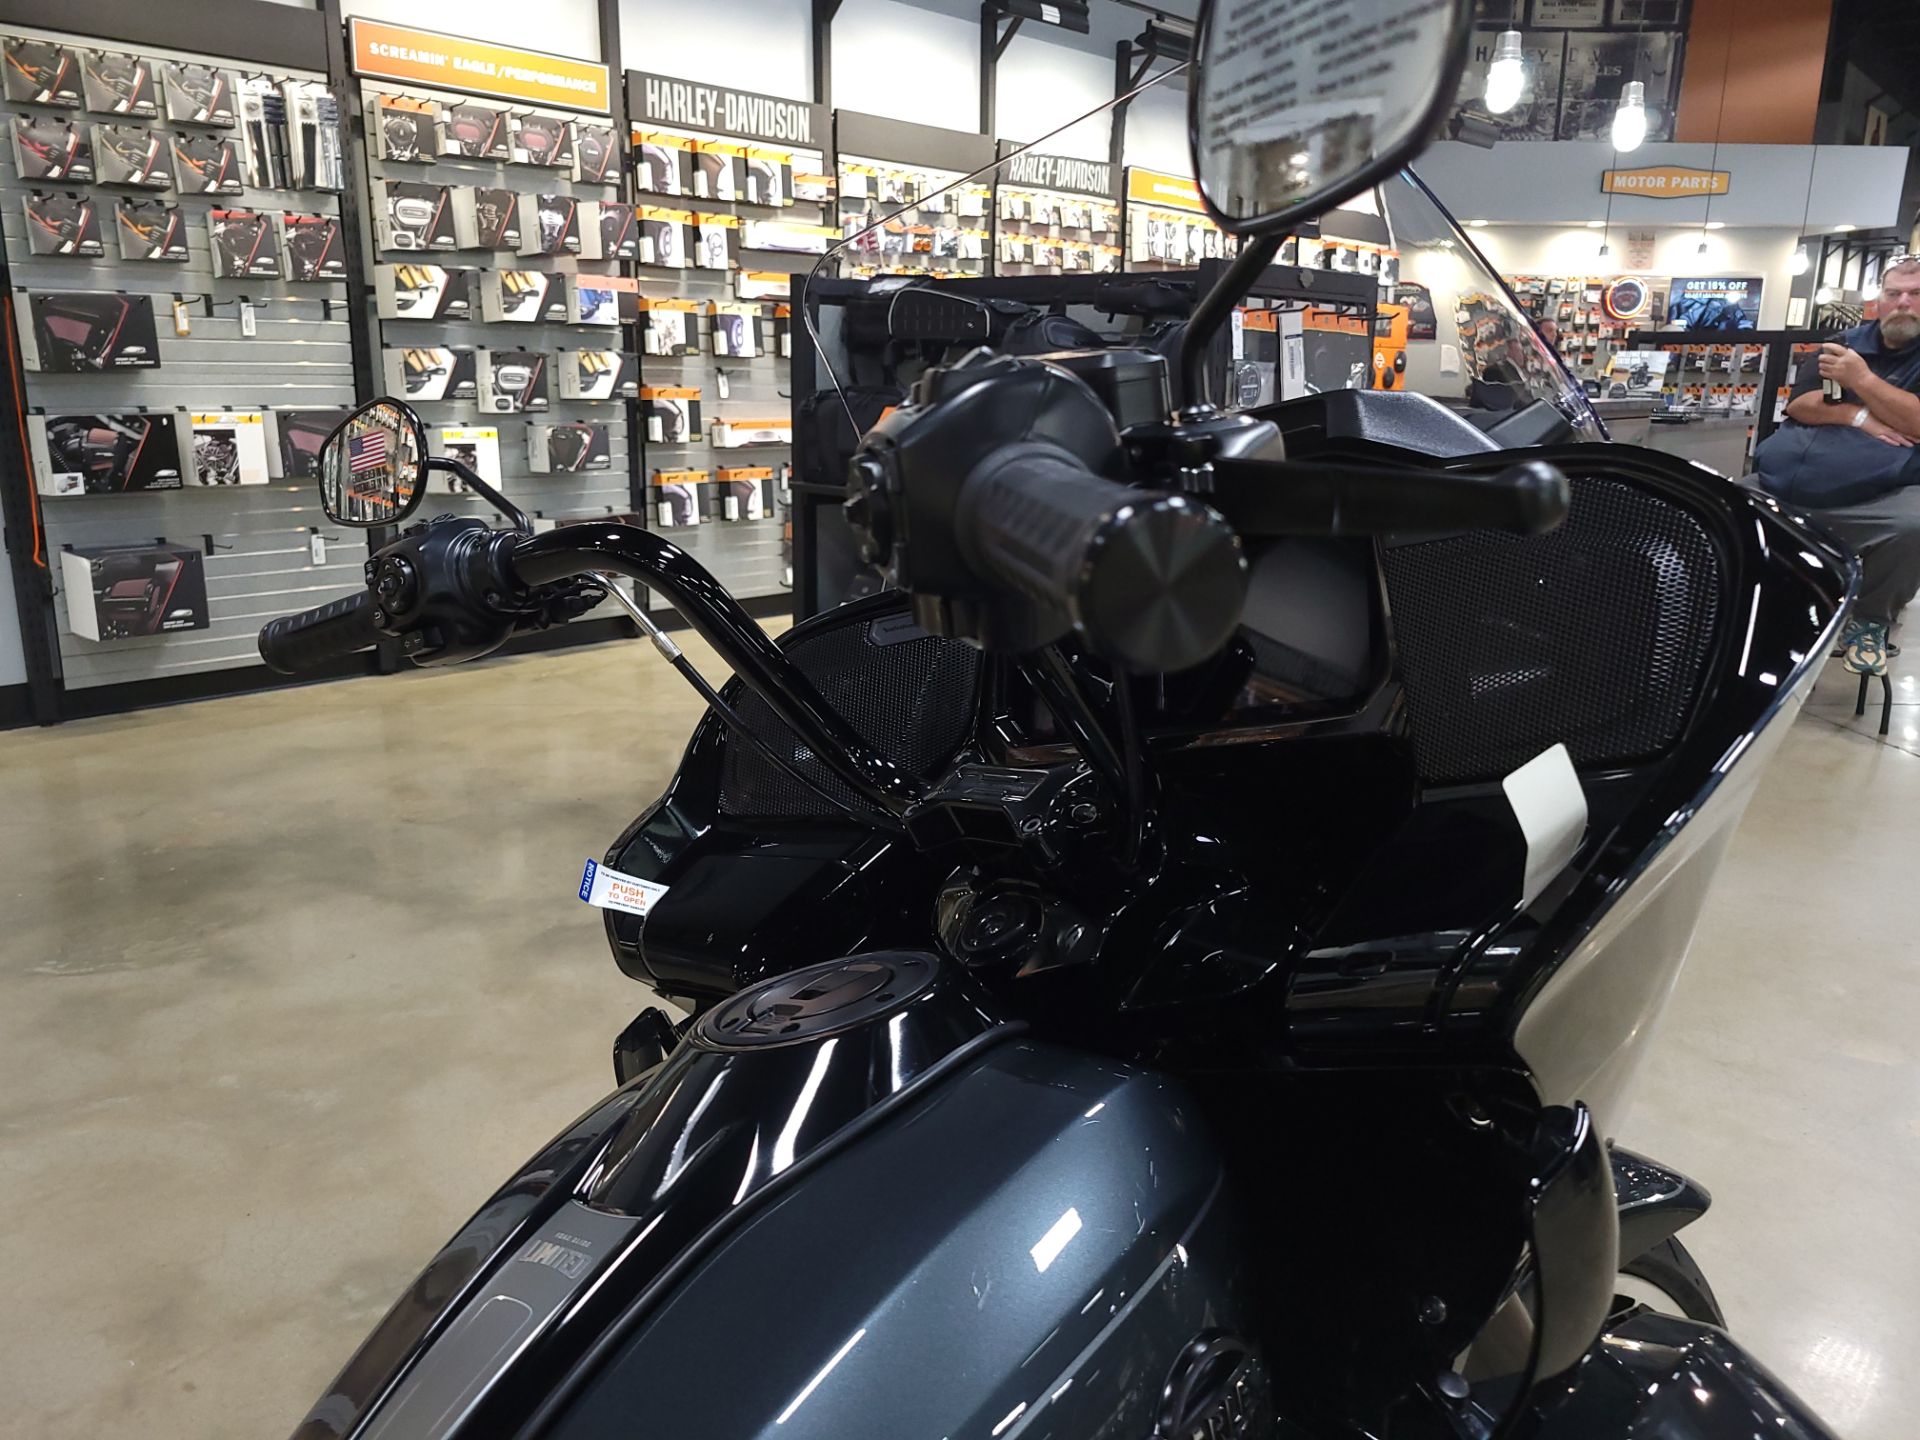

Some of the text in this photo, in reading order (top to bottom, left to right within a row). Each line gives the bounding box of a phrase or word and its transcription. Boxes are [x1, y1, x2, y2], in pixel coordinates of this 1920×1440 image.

[369, 42, 448, 67] SCREAMIN'
[453, 57, 496, 76] EAGLE
[645, 78, 811, 143] HARLEY-DAVIDSON
[1614, 175, 1718, 189] MOTOR PARTS
[1686, 281, 1707, 290] GET
[1728, 281, 1748, 290] OFF
[581, 862, 595, 898] NOTICE
[612, 883, 644, 898] PUSH
[608, 891, 646, 907] TO OPEN
